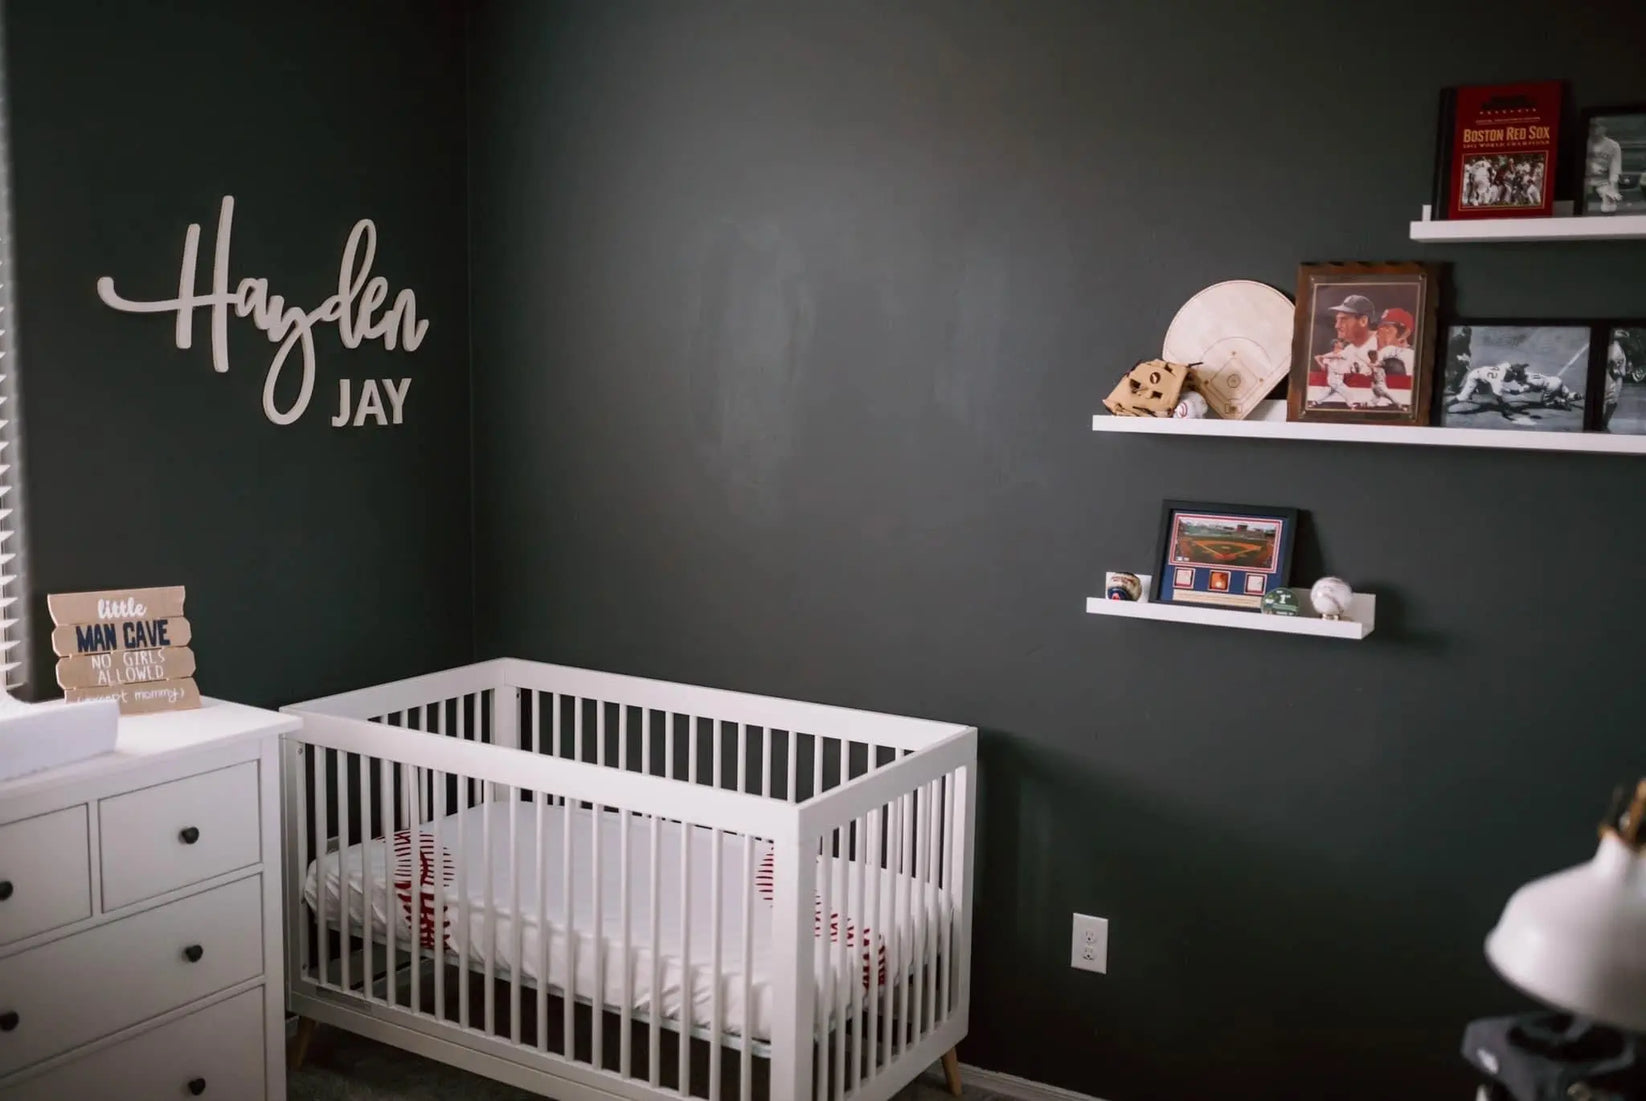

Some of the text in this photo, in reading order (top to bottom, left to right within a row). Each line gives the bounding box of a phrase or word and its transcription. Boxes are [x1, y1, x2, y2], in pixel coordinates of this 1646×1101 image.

[1463, 125, 1550, 143] BOSTON RED SOX
[97, 195, 430, 425] Hayden
[331, 377, 412, 427] JAY
[97, 597, 147, 619] little
[75, 619, 171, 653] MAN CAVE
[91, 650, 166, 670] NO GIRLS
[98, 665, 164, 686] ALLOWED
